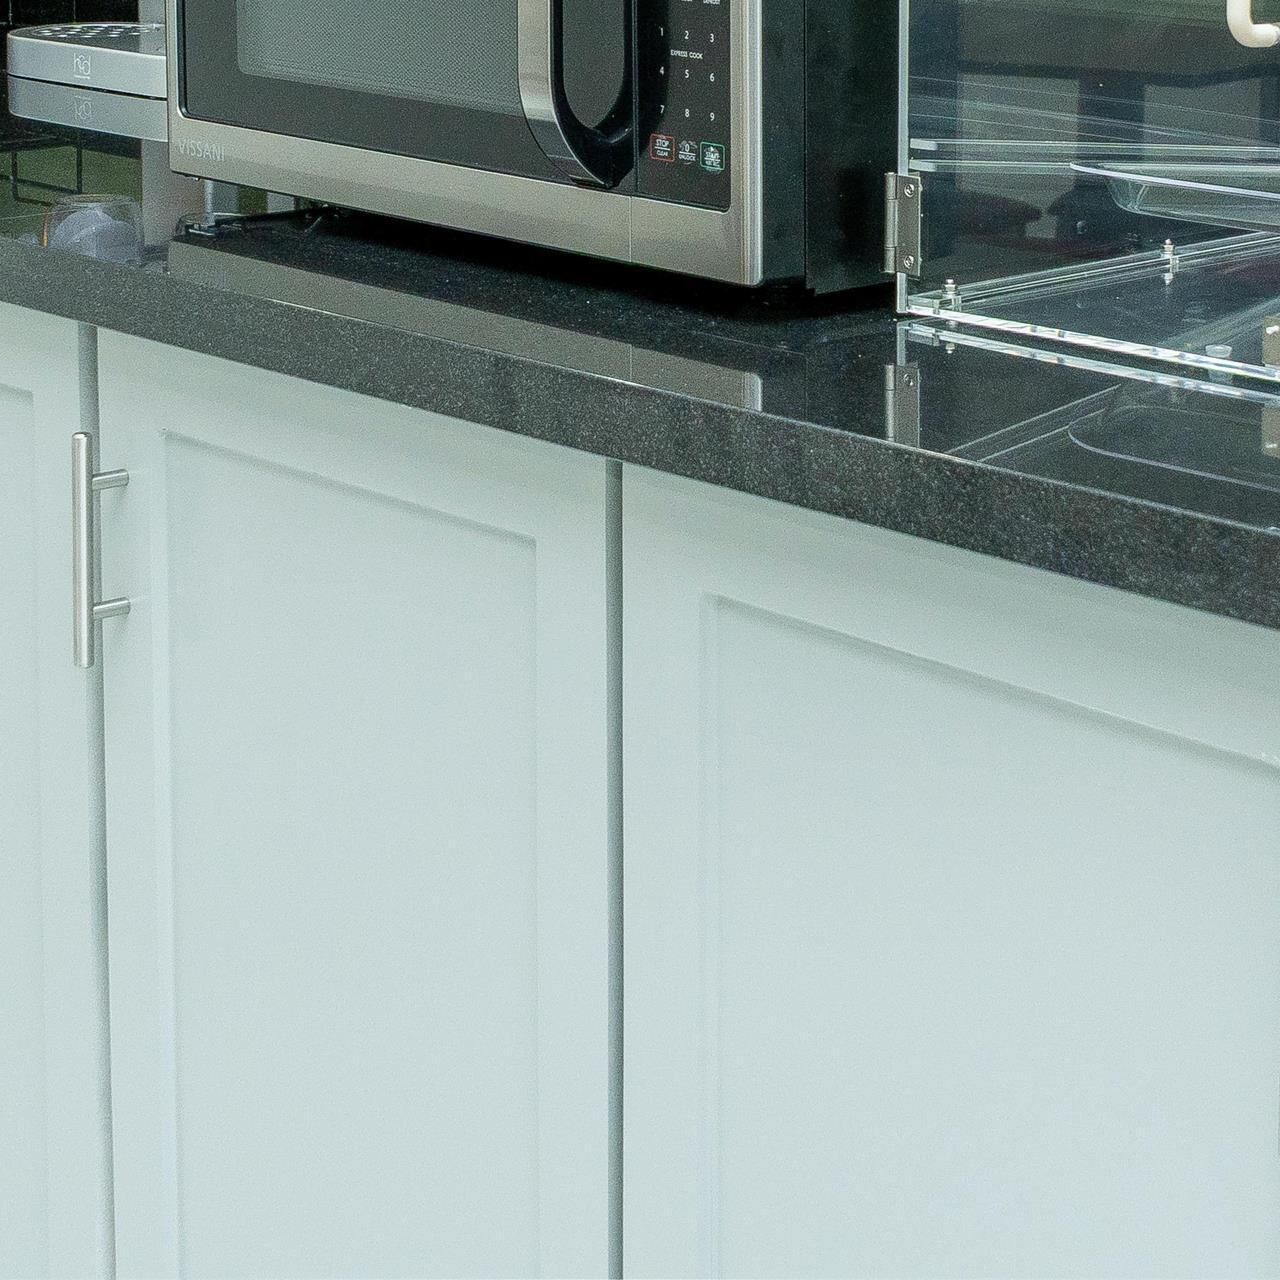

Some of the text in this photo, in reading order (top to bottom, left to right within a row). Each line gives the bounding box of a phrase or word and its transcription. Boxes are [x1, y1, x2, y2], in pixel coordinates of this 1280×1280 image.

[660, 27, 664, 36] 1
[684, 30, 689, 39] 2
[710, 33, 715, 42] 3
[660, 66, 664, 75] 4
[685, 70, 689, 78] 5
[710, 73, 715, 82] 6
[660, 105, 664, 113] 7
[685, 108, 689, 117] 8
[710, 112, 715, 121] 9
[656, 139, 669, 147] STOP
[685, 144, 689, 152] 0
